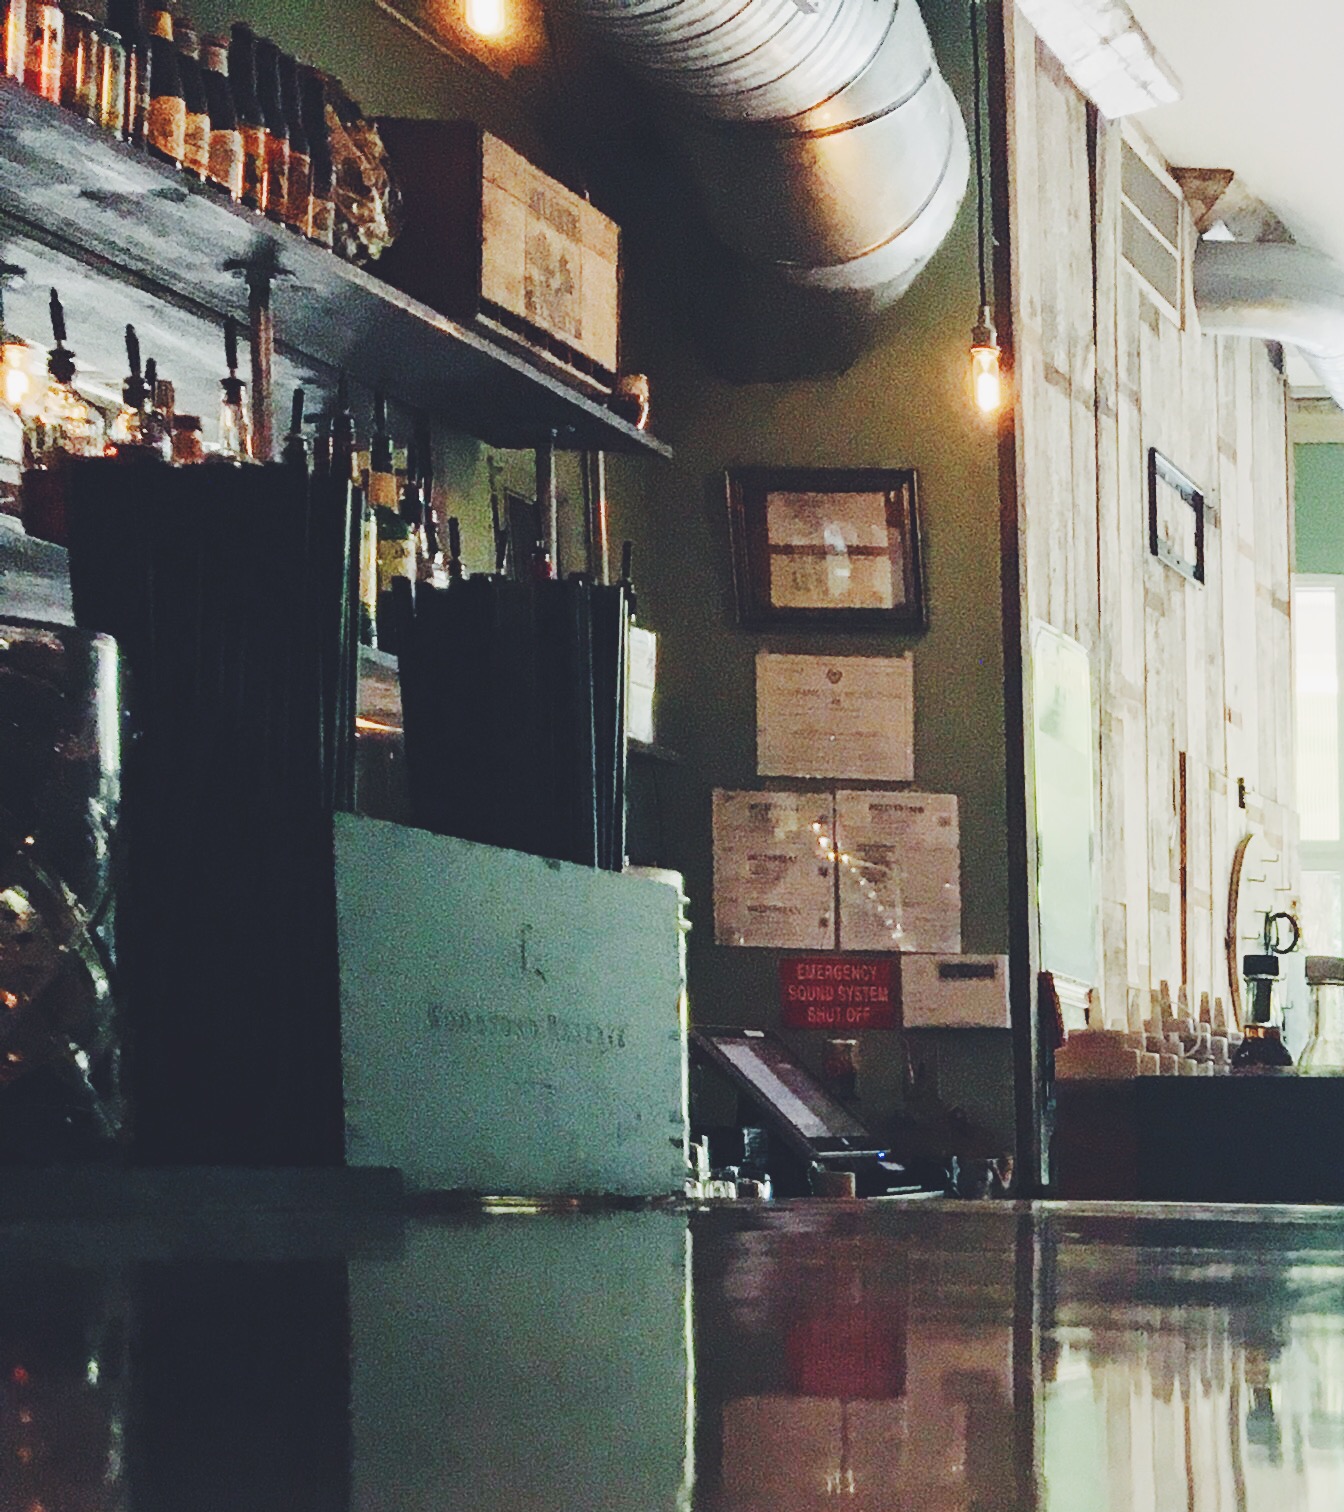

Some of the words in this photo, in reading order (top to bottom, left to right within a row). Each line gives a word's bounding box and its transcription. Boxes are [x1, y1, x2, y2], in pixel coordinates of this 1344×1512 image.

[797, 963, 877, 981] EMERGENCY
[788, 984, 834, 1001] SOUND
[837, 984, 889, 1002] SYSTEM
[807, 1006, 842, 1023] SHUT
[845, 1006, 871, 1023] OFF
